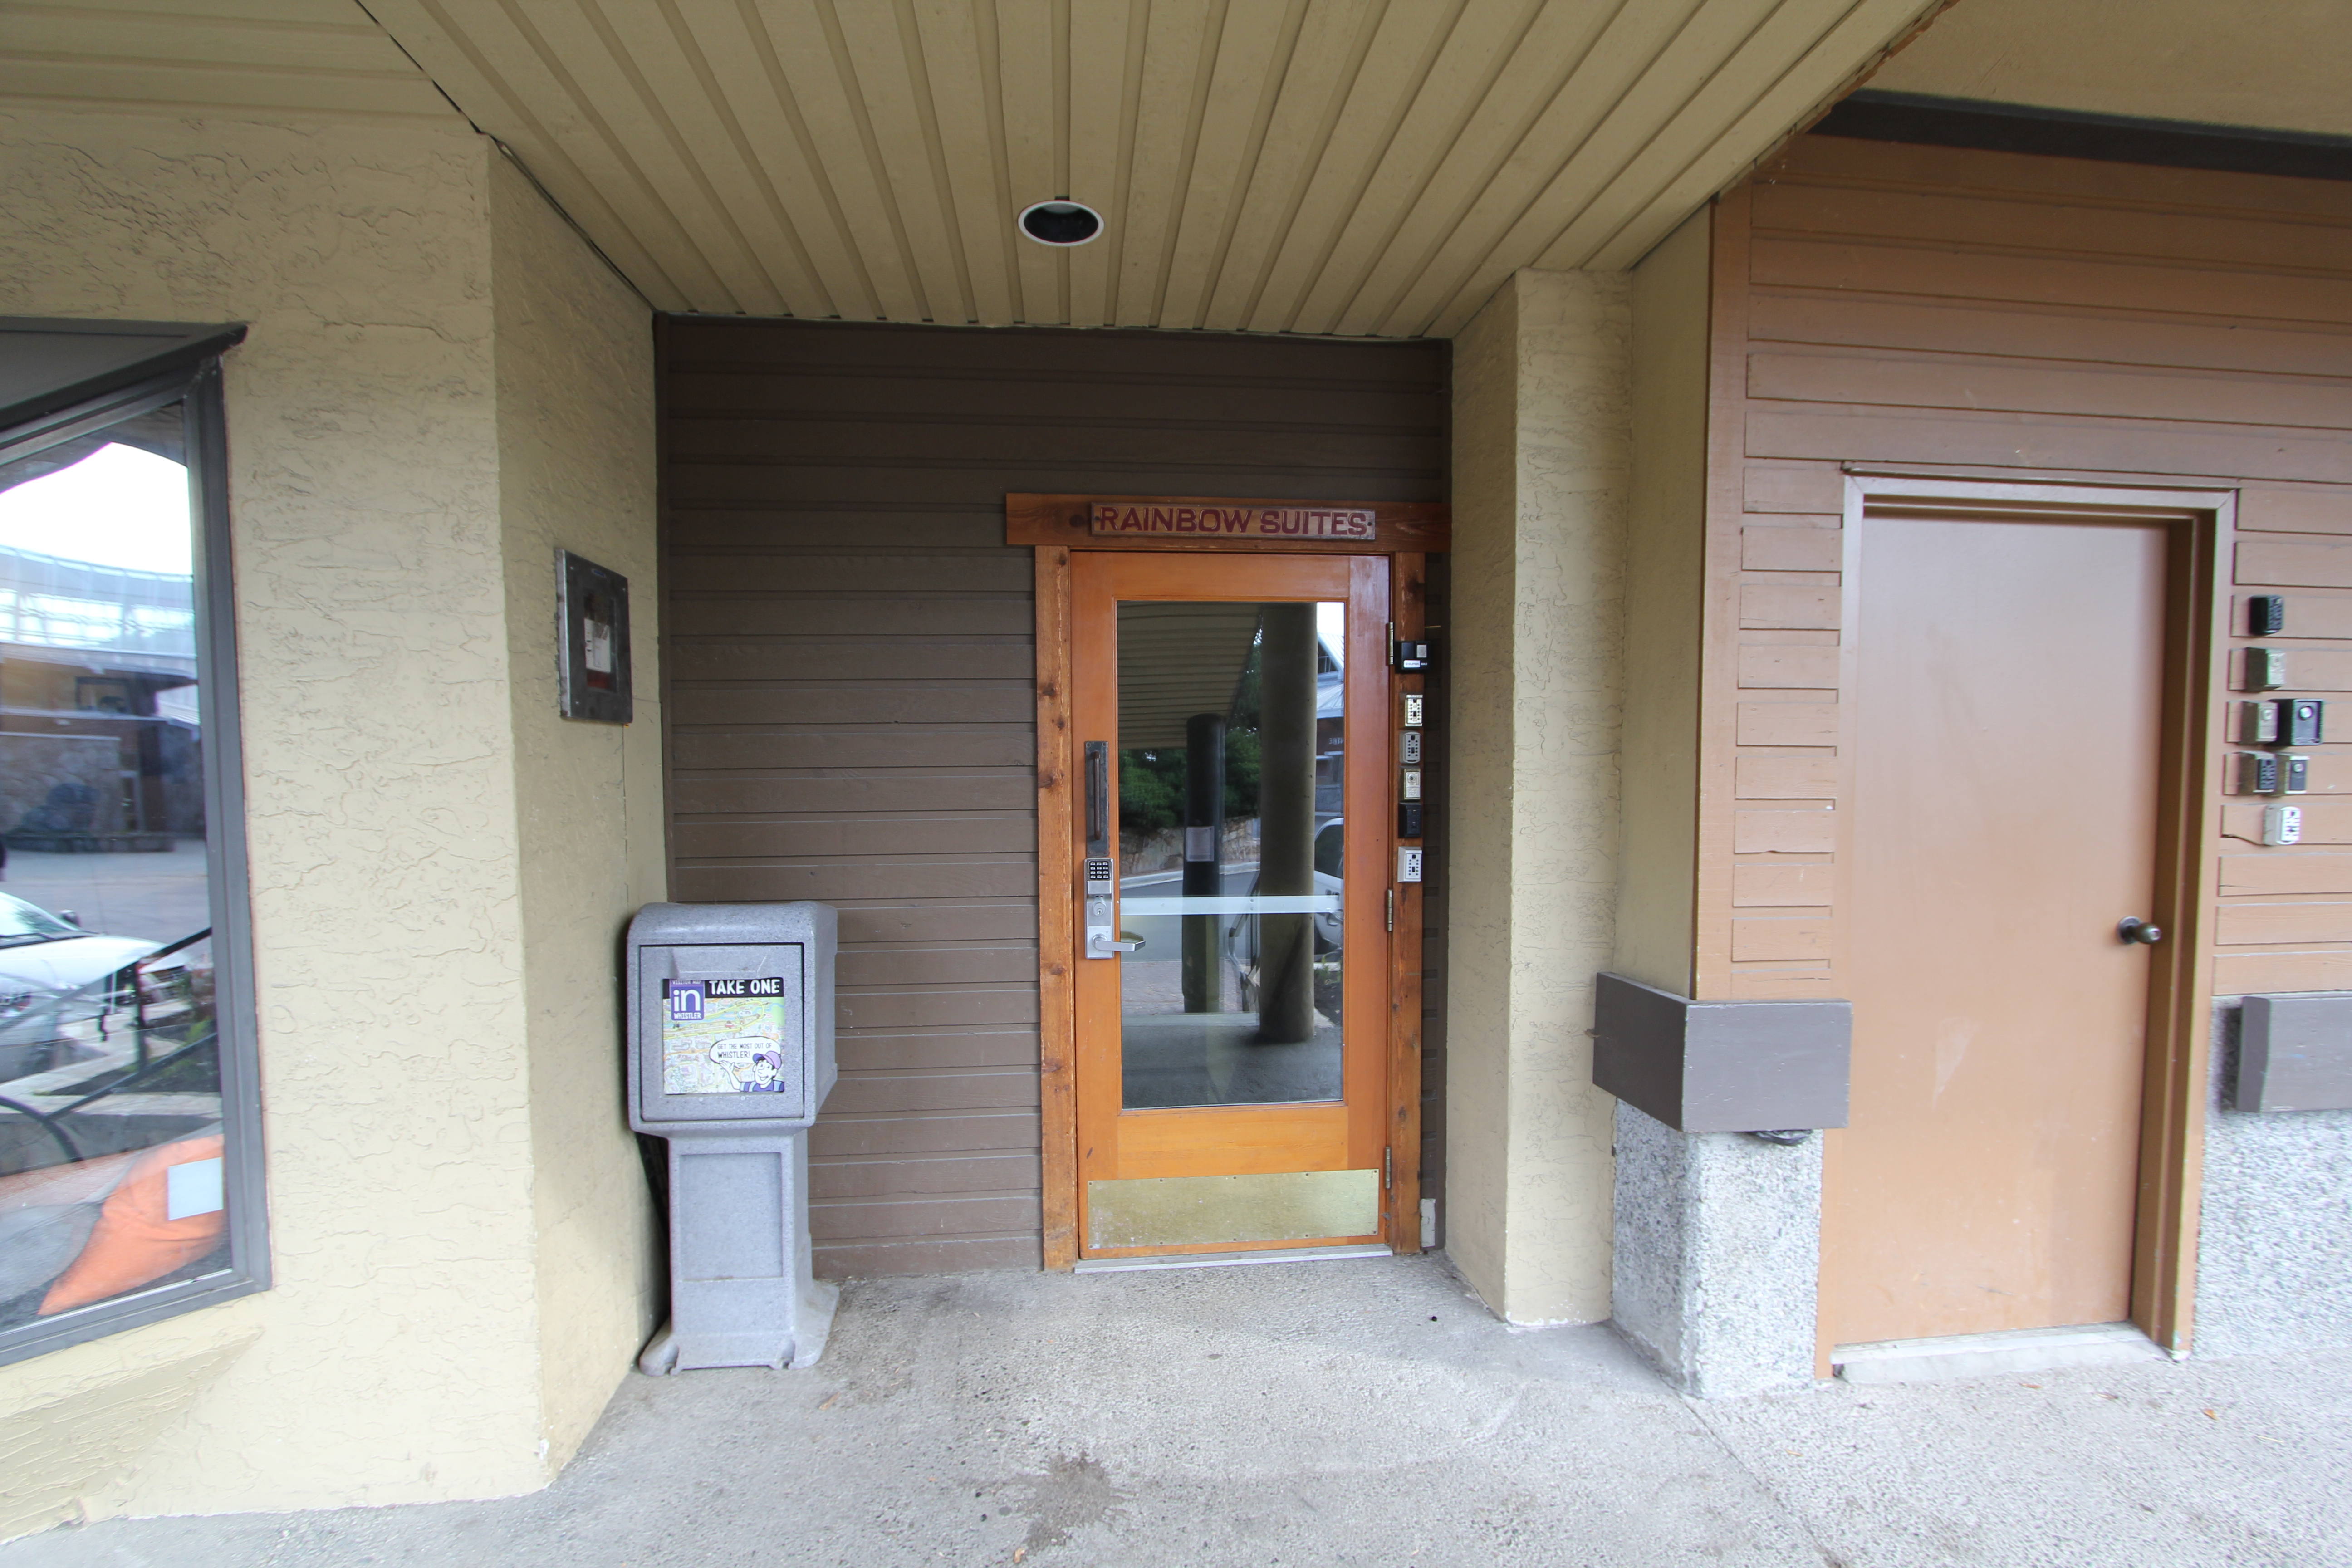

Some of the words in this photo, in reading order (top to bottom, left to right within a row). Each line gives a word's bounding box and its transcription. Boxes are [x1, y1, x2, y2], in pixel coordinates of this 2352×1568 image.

[1100, 506, 1252, 533] RAINBOW
[1259, 510, 1367, 535] SUITES
[709, 980, 745, 995] TAKE
[750, 979, 780, 994] ONE
[673, 989, 701, 1011] in
